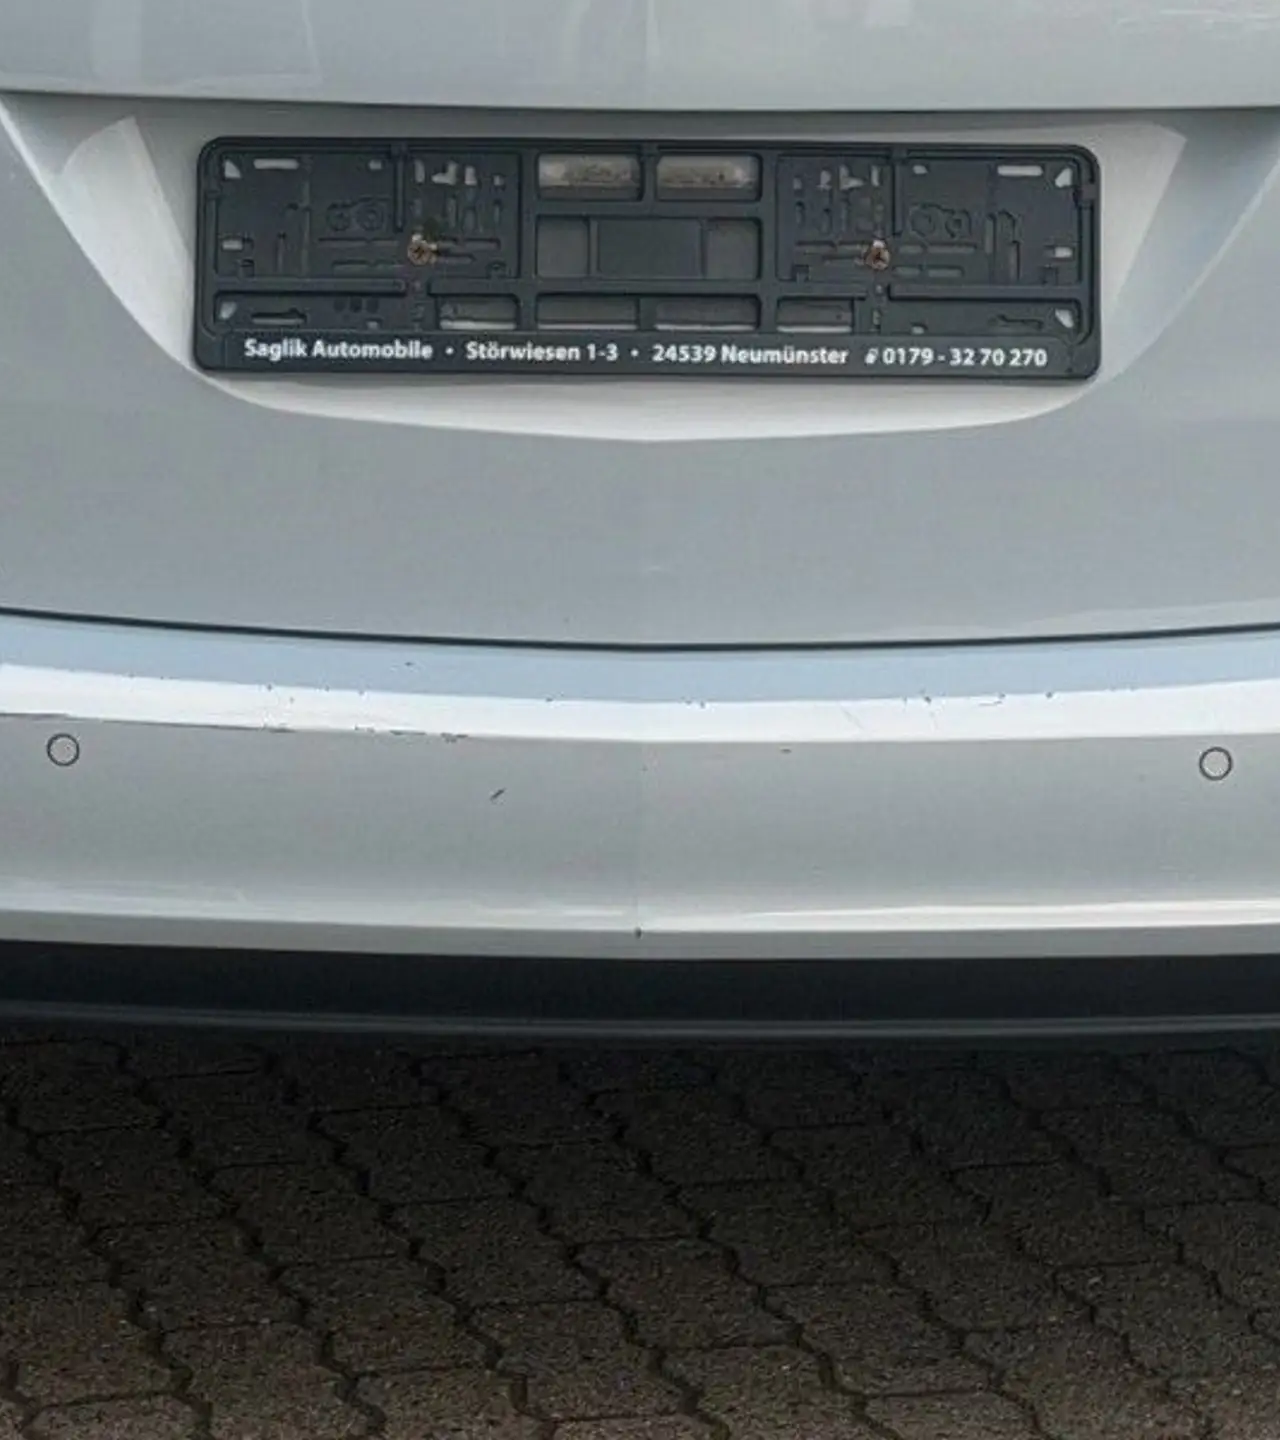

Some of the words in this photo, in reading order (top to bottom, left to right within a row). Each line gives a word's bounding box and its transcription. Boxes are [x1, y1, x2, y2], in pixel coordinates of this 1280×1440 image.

[243, 337, 307, 362] Saglik
[311, 339, 433, 359] Automobile
[465, 340, 580, 361] Störwiesen
[586, 343, 618, 361] 1-3
[651, 343, 717, 363] 24539
[721, 343, 849, 365] Neumünster
[882, 346, 934, 366] 0179
[1008, 346, 1048, 367] 270
